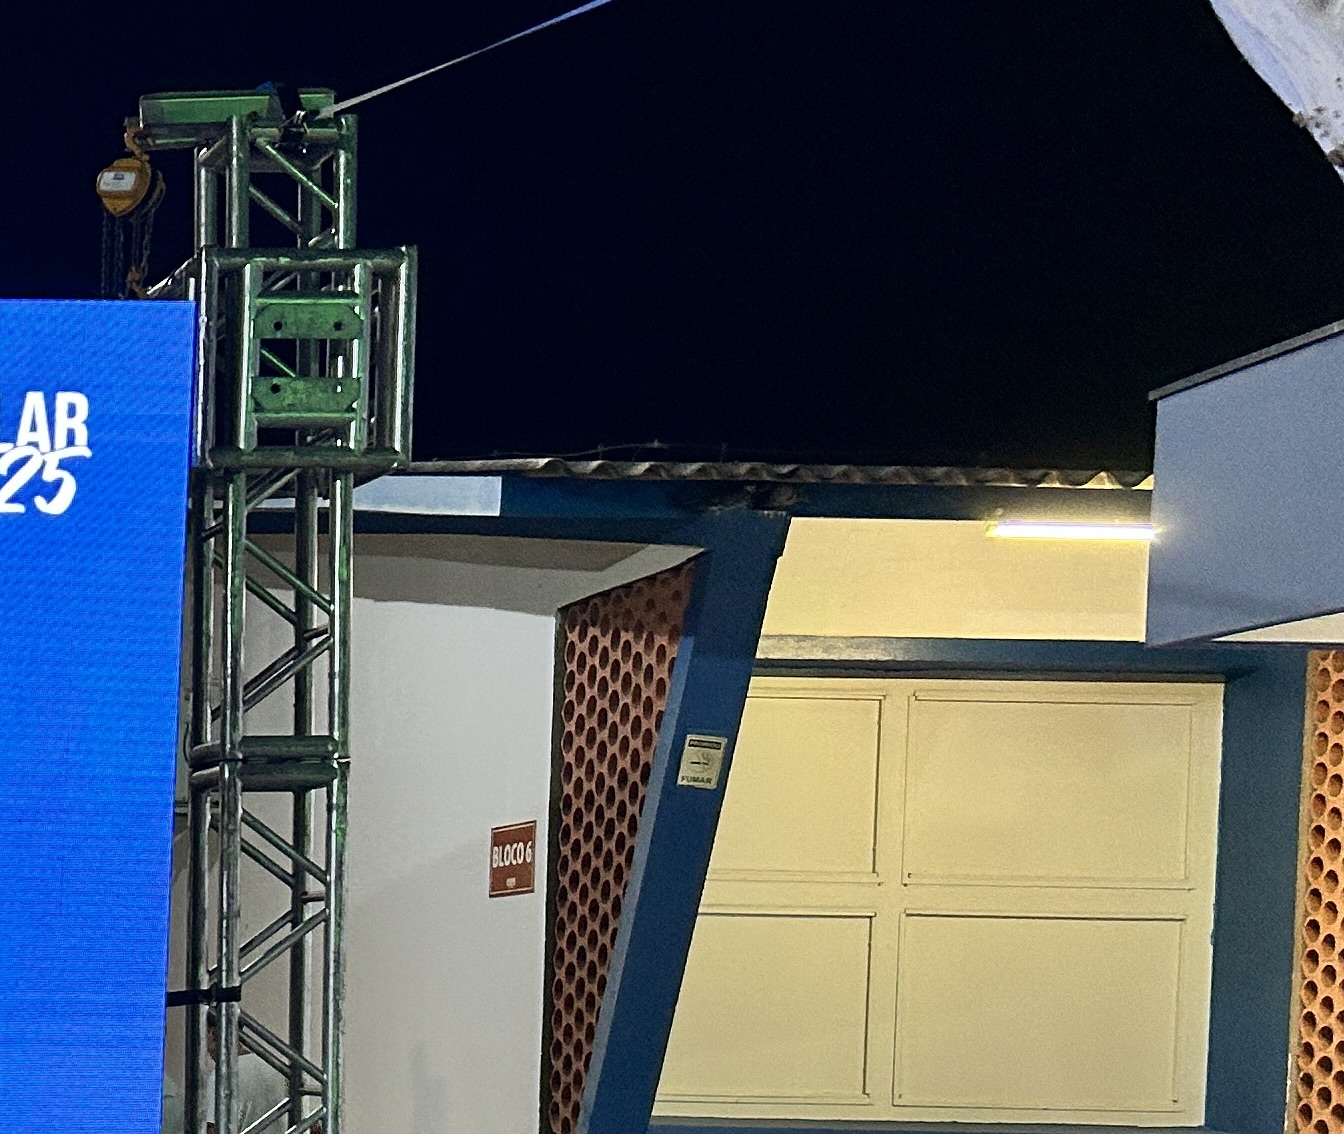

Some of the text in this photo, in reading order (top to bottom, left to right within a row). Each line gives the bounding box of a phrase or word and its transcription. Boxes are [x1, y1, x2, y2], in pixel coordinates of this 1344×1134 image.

[681, 775, 713, 785] FUMAR
[492, 841, 533, 868] BLOCO 6
